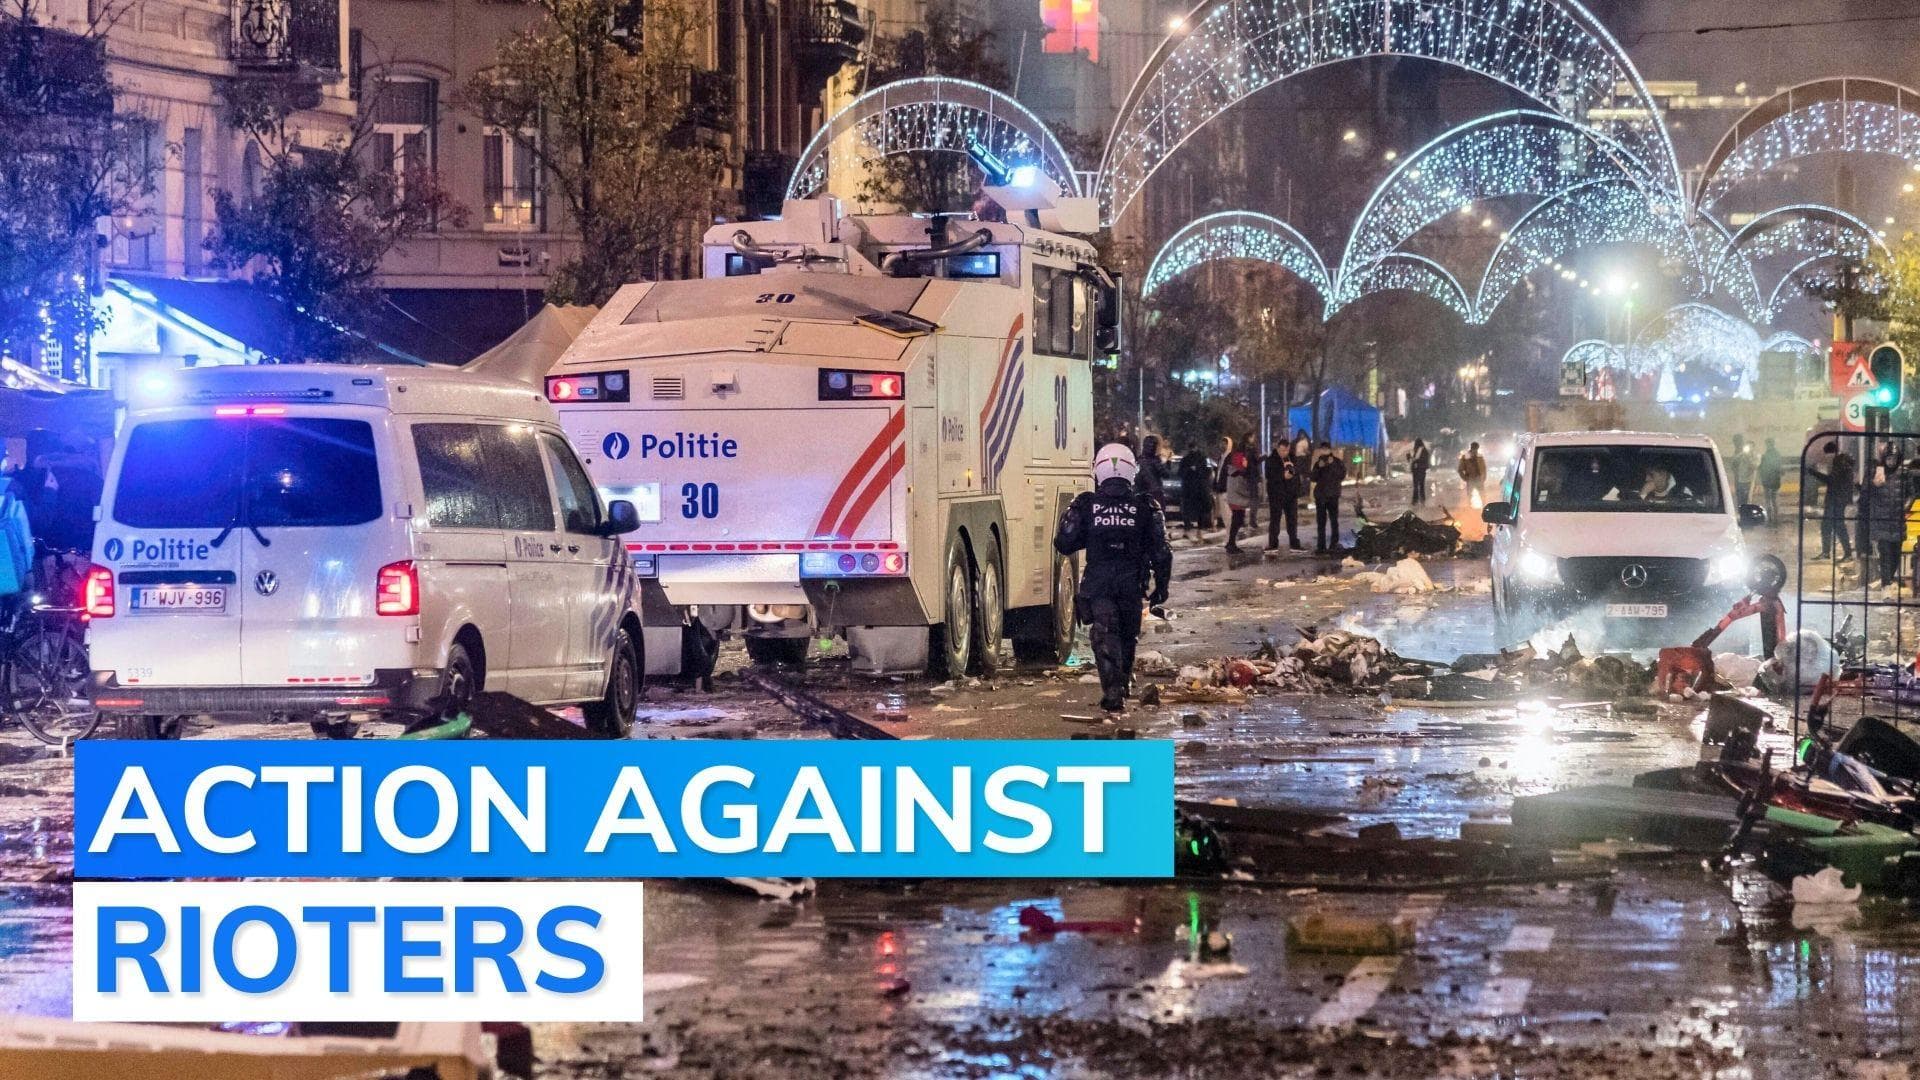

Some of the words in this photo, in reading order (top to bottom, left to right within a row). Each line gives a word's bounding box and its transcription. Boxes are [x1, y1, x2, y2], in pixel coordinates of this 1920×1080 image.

[756, 293, 795, 304] 30
[1054, 374, 1067, 450] 30
[948, 417, 964, 441] Police
[641, 432, 738, 459] Politie
[681, 482, 719, 519] 30
[1094, 515, 1136, 526] Police
[132, 538, 209, 561] Politie
[522, 537, 545, 558] Police
[142, 590, 222, 606] 1-WJV-996
